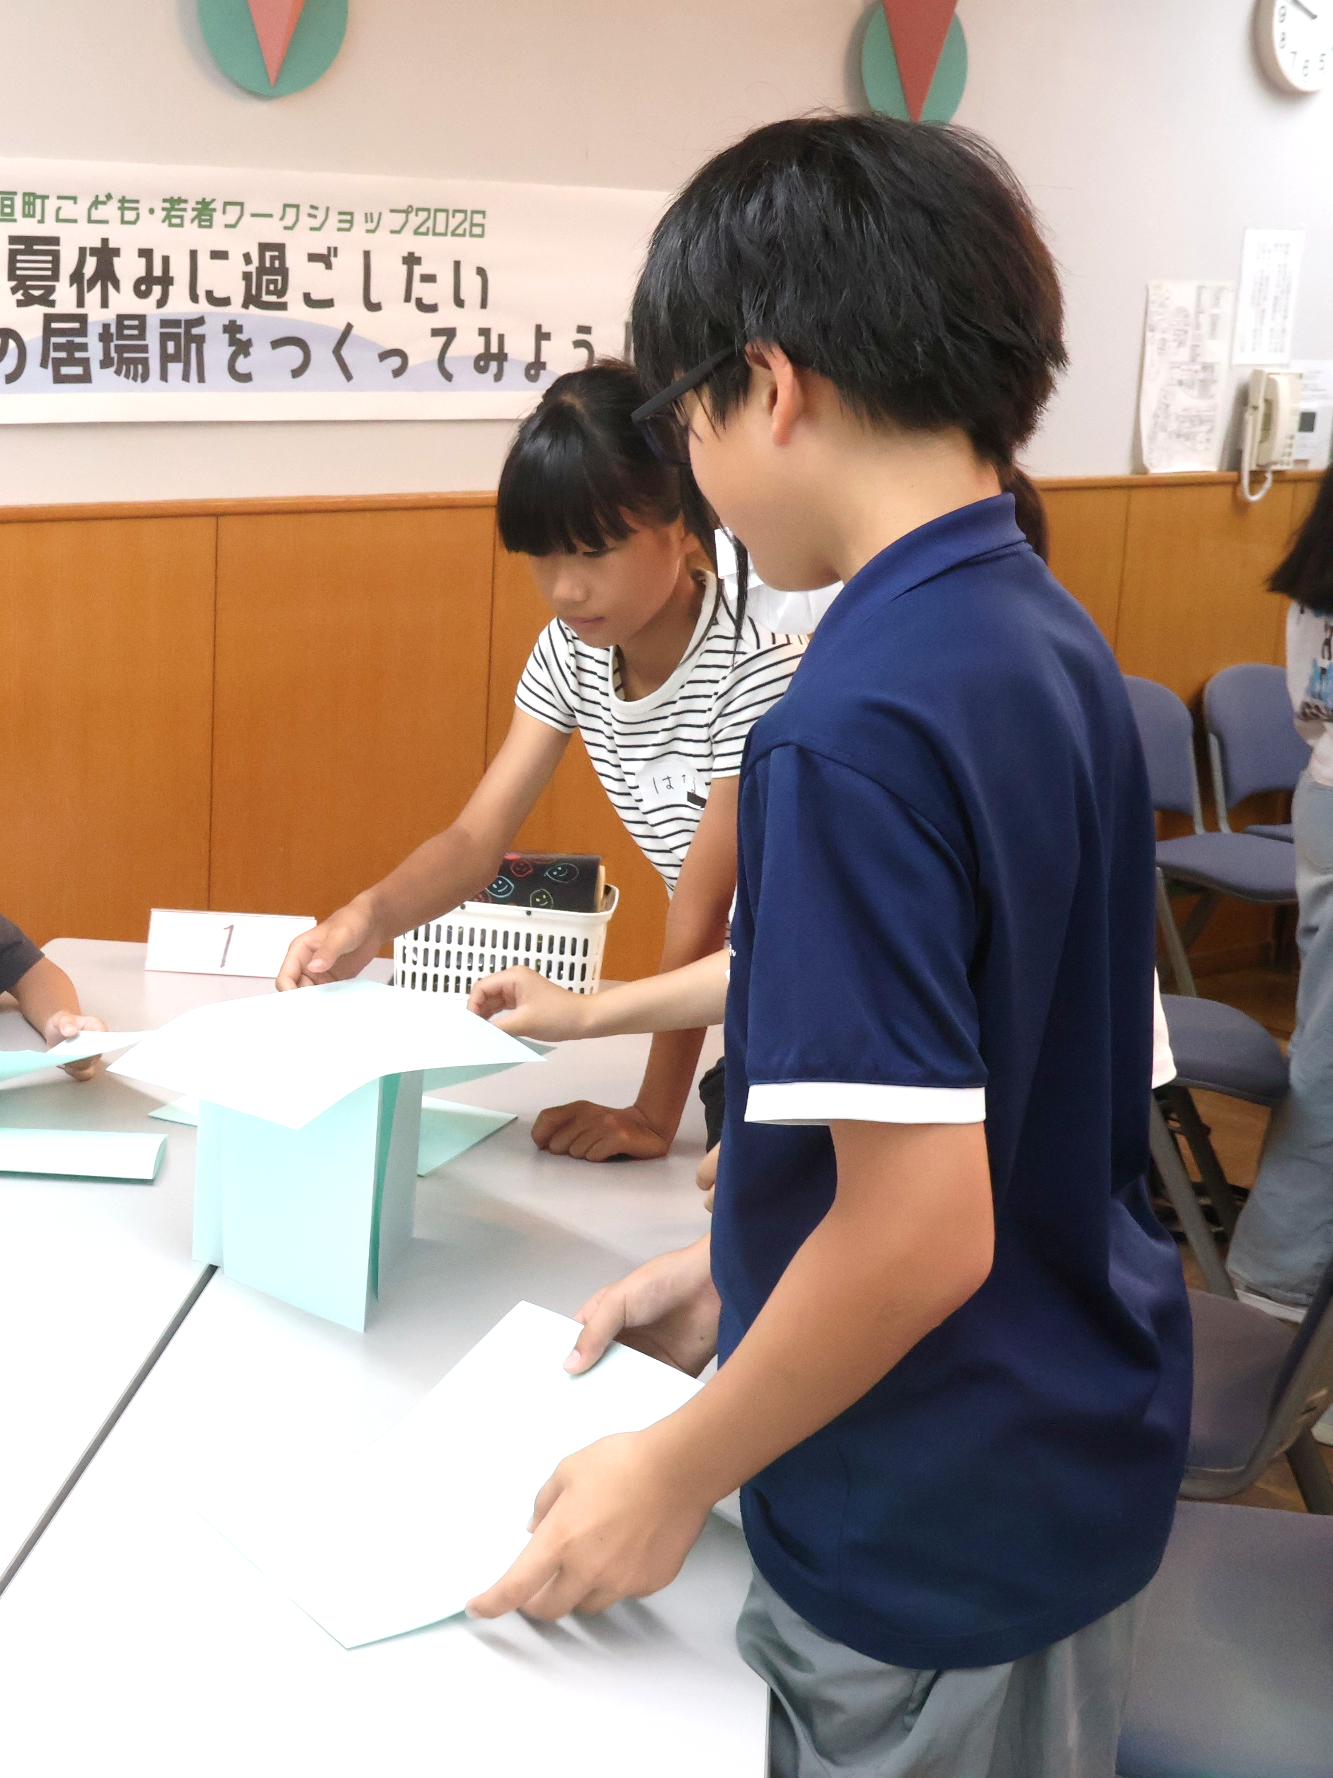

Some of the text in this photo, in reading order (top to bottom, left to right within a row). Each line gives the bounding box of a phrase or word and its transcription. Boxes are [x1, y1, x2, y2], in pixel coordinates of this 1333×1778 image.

[1290, 51, 1298, 69] 7
[1318, 53, 1327, 71] 5
[7, 235, 490, 313] 夏休みに過ごしたい
[220, 924, 235, 969] 1
